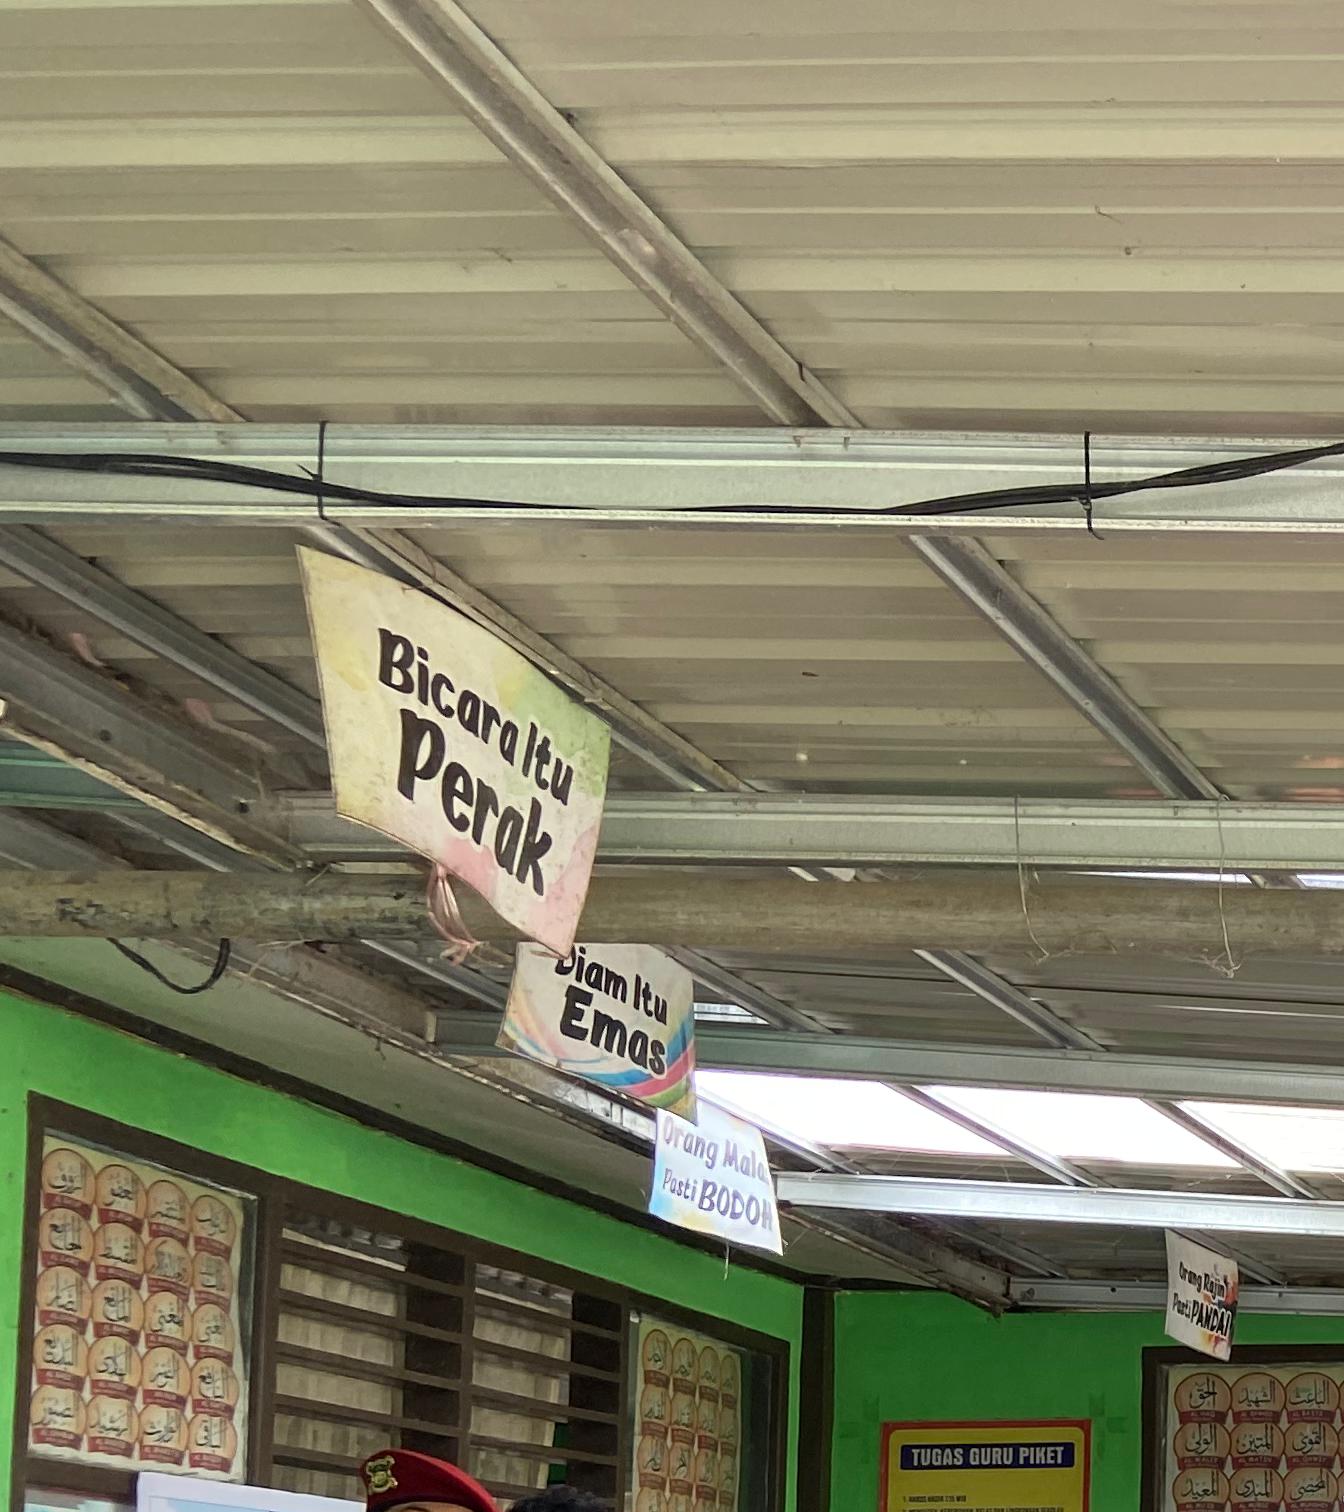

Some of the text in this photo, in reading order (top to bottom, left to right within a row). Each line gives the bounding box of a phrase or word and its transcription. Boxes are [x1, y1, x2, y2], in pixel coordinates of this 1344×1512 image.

[377, 627, 575, 807] Bicara Itu
[396, 708, 554, 896] Perak
[632, 973, 669, 1026] Itu
[559, 985, 667, 1076] Emas
[662, 1116, 718, 1170] Orang
[662, 1167, 774, 1232] Pasti BODOH
[1178, 1260, 1203, 1294] Orang
[911, 1446, 1065, 1467] TUGAS GURU PIKET
